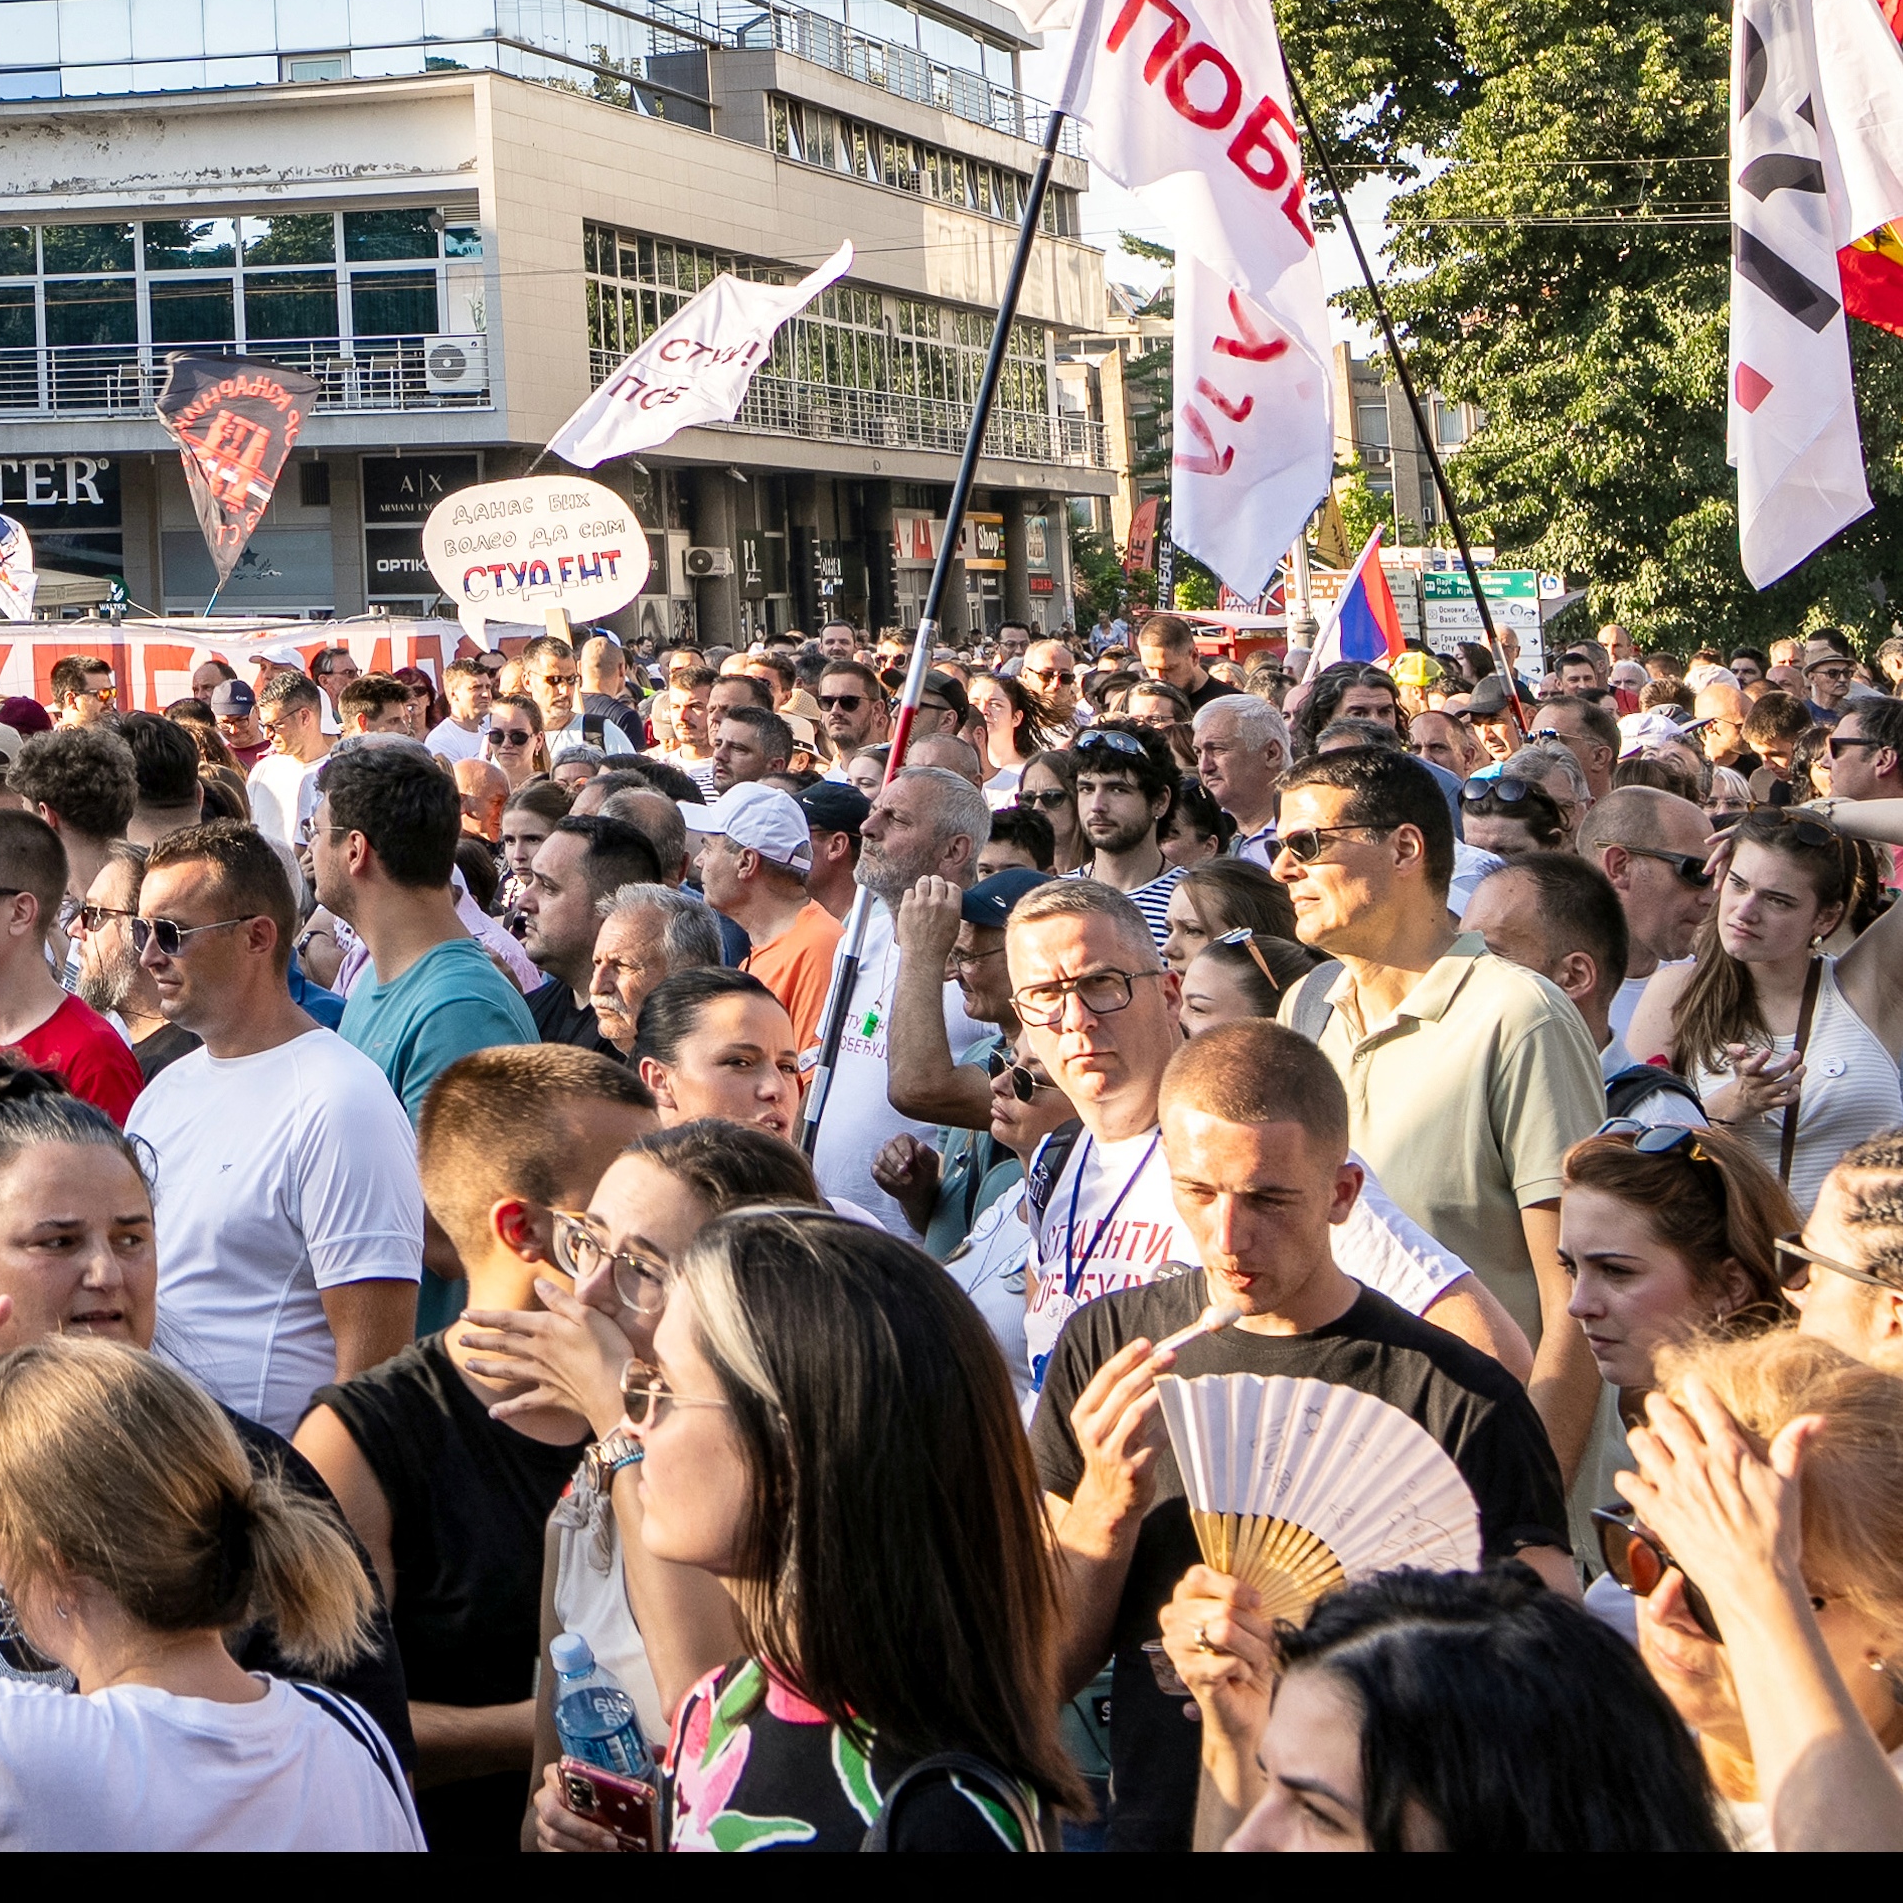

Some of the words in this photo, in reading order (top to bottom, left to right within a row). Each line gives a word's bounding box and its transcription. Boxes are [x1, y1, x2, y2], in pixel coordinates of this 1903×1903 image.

[378, 503, 415, 512] ARMANI
[452, 496, 534, 526] ДАНАС
[548, 492, 591, 512] БИХ
[529, 524, 568, 549] ДА
[579, 518, 626, 539] САМ
[978, 524, 999, 558] Shop
[463, 549, 622, 602] СТУДЕНТ
[1436, 587, 1452, 595] Park
[1439, 615, 1457, 624] Basic
[839, 1037, 889, 1061] ОБЕЂУЈ
